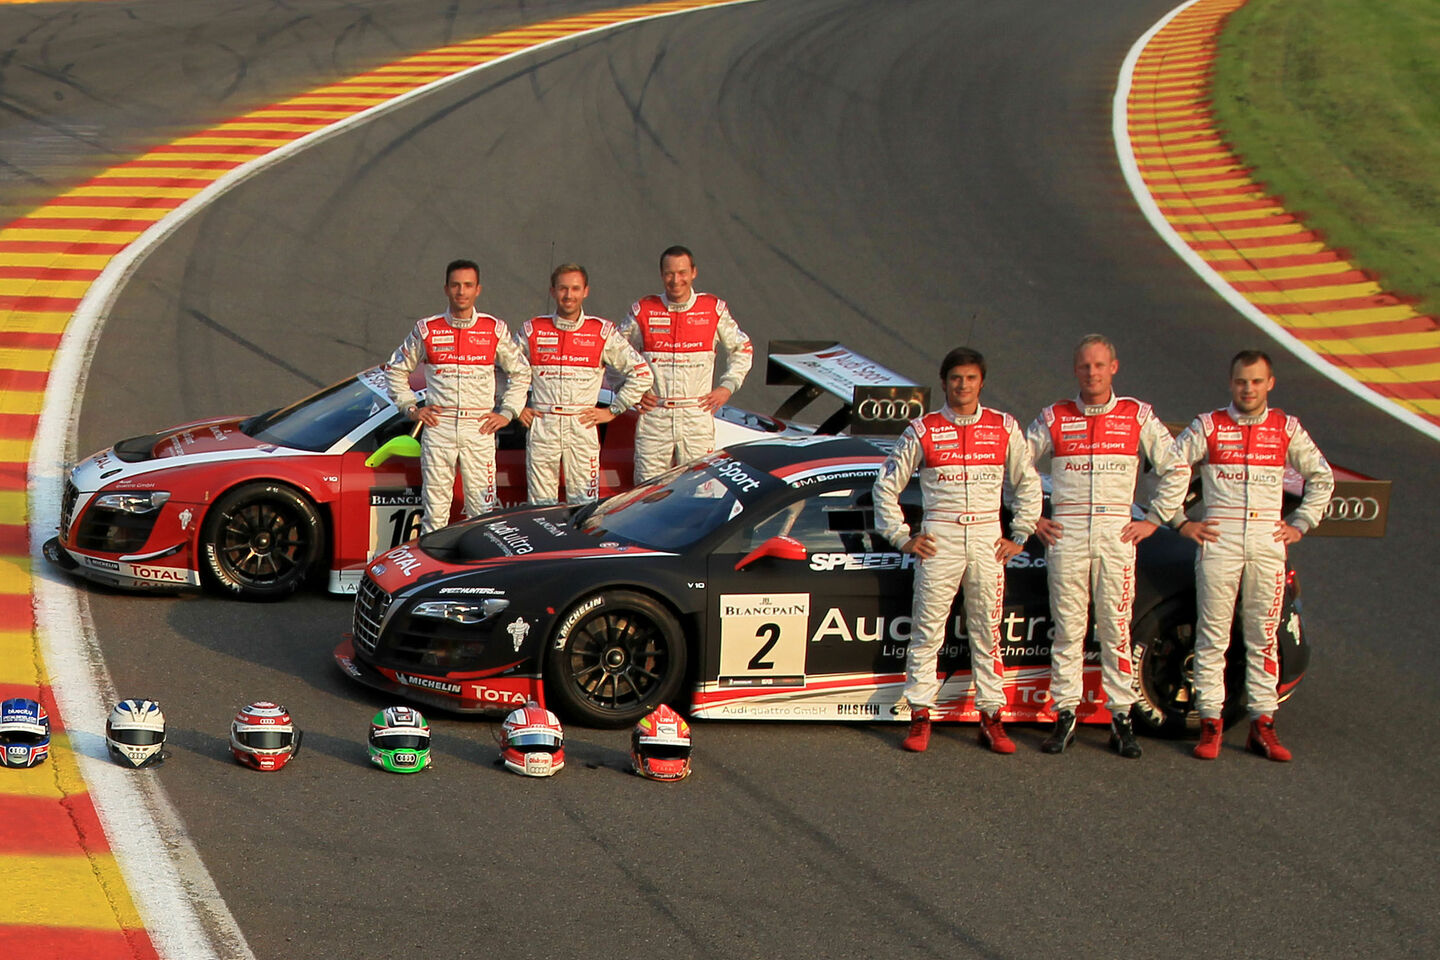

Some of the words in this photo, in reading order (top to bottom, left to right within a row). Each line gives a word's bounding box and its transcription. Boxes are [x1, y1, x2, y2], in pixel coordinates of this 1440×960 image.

[1101, 442, 1126, 450] Sport
[587, 456, 597, 498] Sport
[719, 461, 760, 493] Sport
[818, 470, 880, 482] Bonanomi
[1098, 463, 1127, 471] ultra
[372, 495, 422, 505] BLANCP
[130, 564, 184, 581] TOTAL
[207, 545, 234, 587] MICHELIN
[991, 572, 1005, 619] Sport
[1118, 565, 1131, 612] Sport
[1267, 569, 1283, 613] Sport
[561, 597, 602, 637] MICHELIN
[725, 605, 805, 617] BLANCPAIN
[812, 607, 911, 642] Aud
[748, 623, 780, 670] 2
[988, 620, 1001, 660] Audi
[1116, 618, 1128, 653] Audi
[1263, 617, 1278, 656] Audi
[409, 676, 461, 692] MICHELIN
[1017, 686, 1103, 703] TOL
[722, 706, 747, 714] Audi
[750, 706, 790, 716] quattro
[793, 707, 827, 715] GmbH
[837, 704, 880, 716] BILSTEIN
